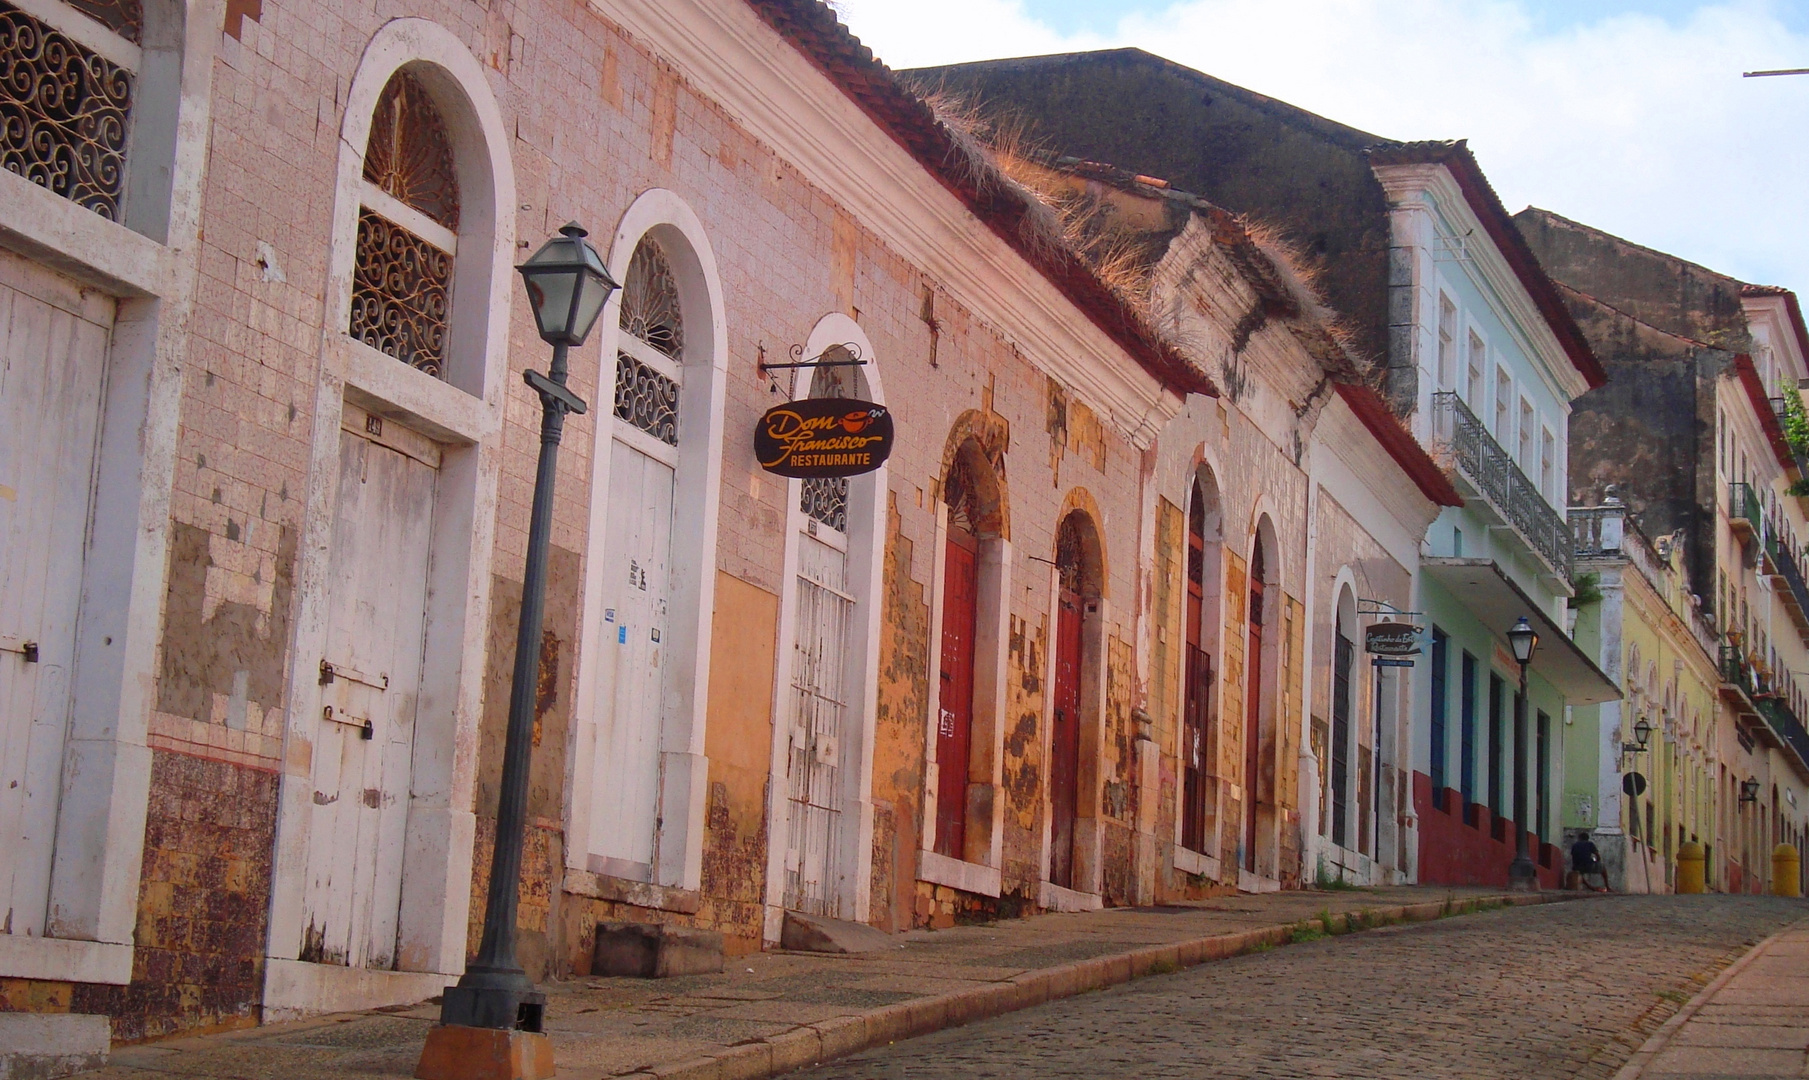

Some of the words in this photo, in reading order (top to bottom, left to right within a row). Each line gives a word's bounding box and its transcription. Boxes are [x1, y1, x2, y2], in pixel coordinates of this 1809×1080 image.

[766, 410, 838, 440] Dom
[763, 431, 883, 467] Francisco
[791, 453, 871, 467] RESTAURANTE
